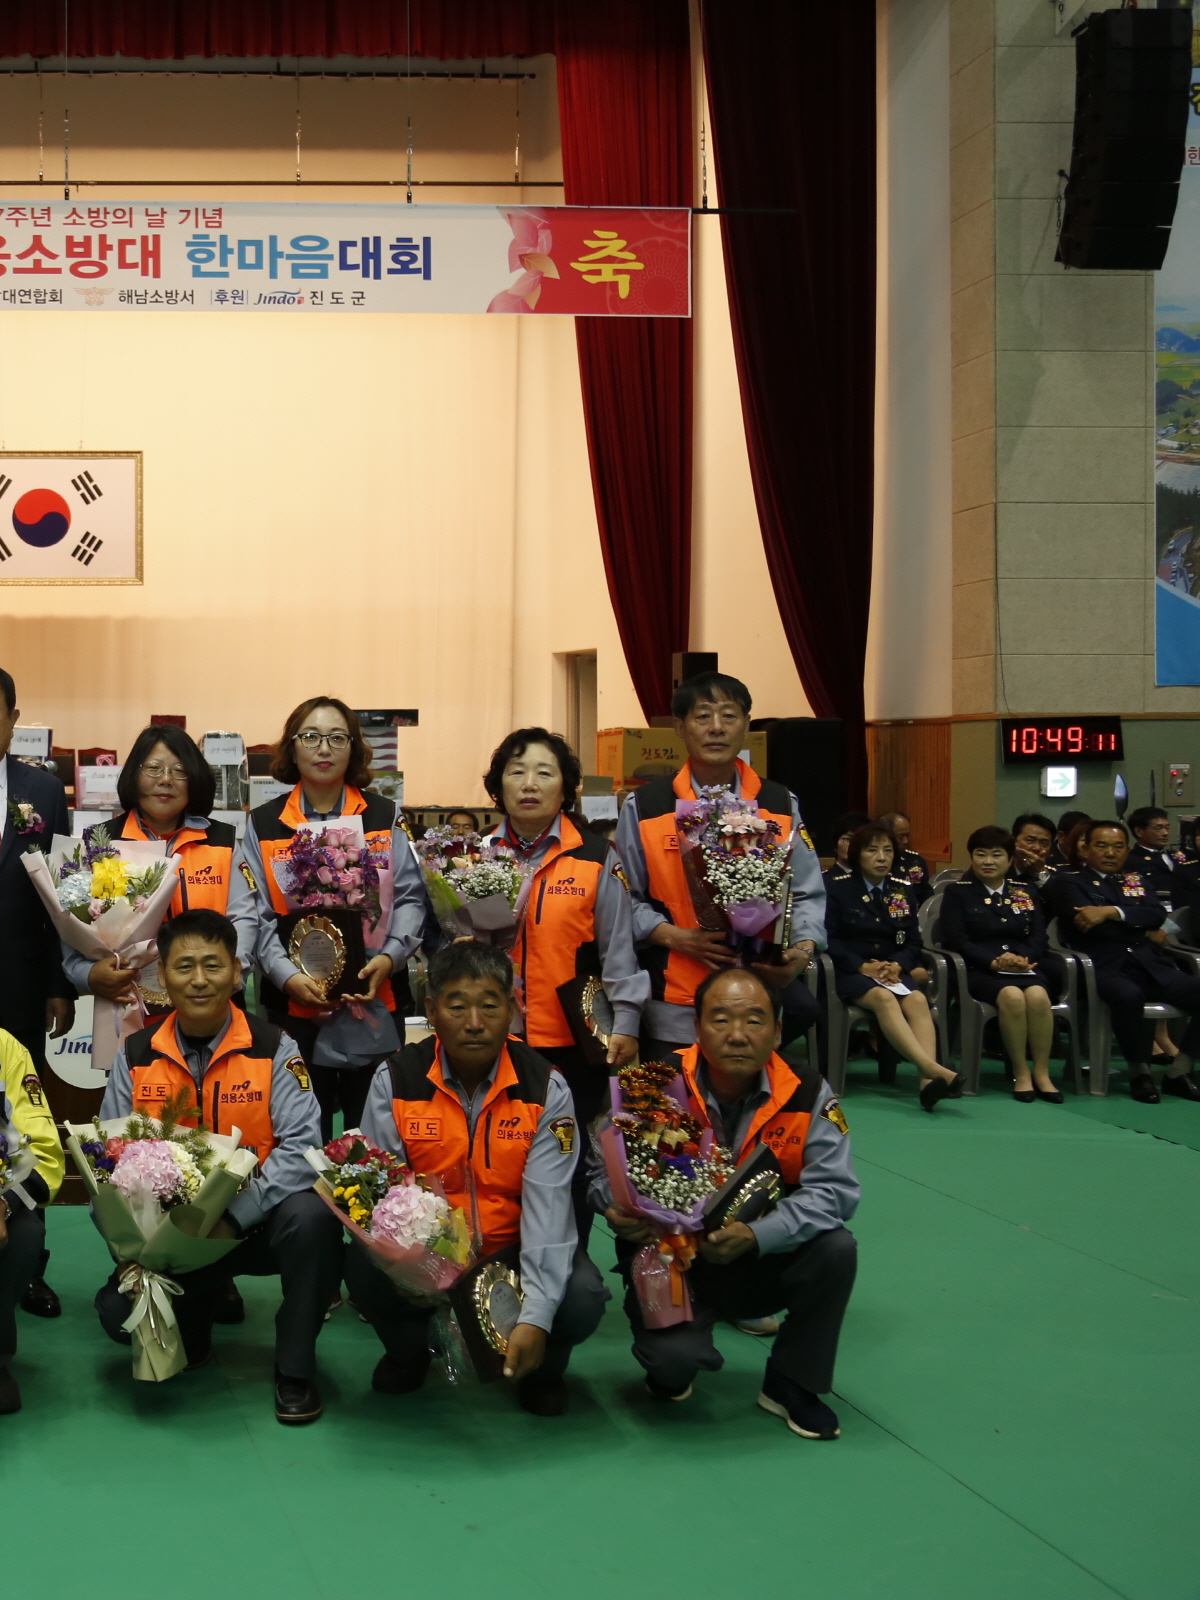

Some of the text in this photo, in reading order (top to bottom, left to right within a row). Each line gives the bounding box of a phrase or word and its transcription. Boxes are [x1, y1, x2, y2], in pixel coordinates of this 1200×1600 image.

[63, 207, 134, 229] 소방의
[144, 208, 167, 229] 날
[178, 208, 223, 229] 기념
[570, 230, 644, 299] 축
[118, 289, 194, 306] 해남소방서
[214, 289, 244, 306] 후원
[254, 292, 296, 305] Jindo
[187, 875, 222, 885] 의용소방대
[547, 886, 586, 897] 의용소방대
[220, 1090, 263, 1104] 의용소방대
[496, 1129, 537, 1142] 의용소방
